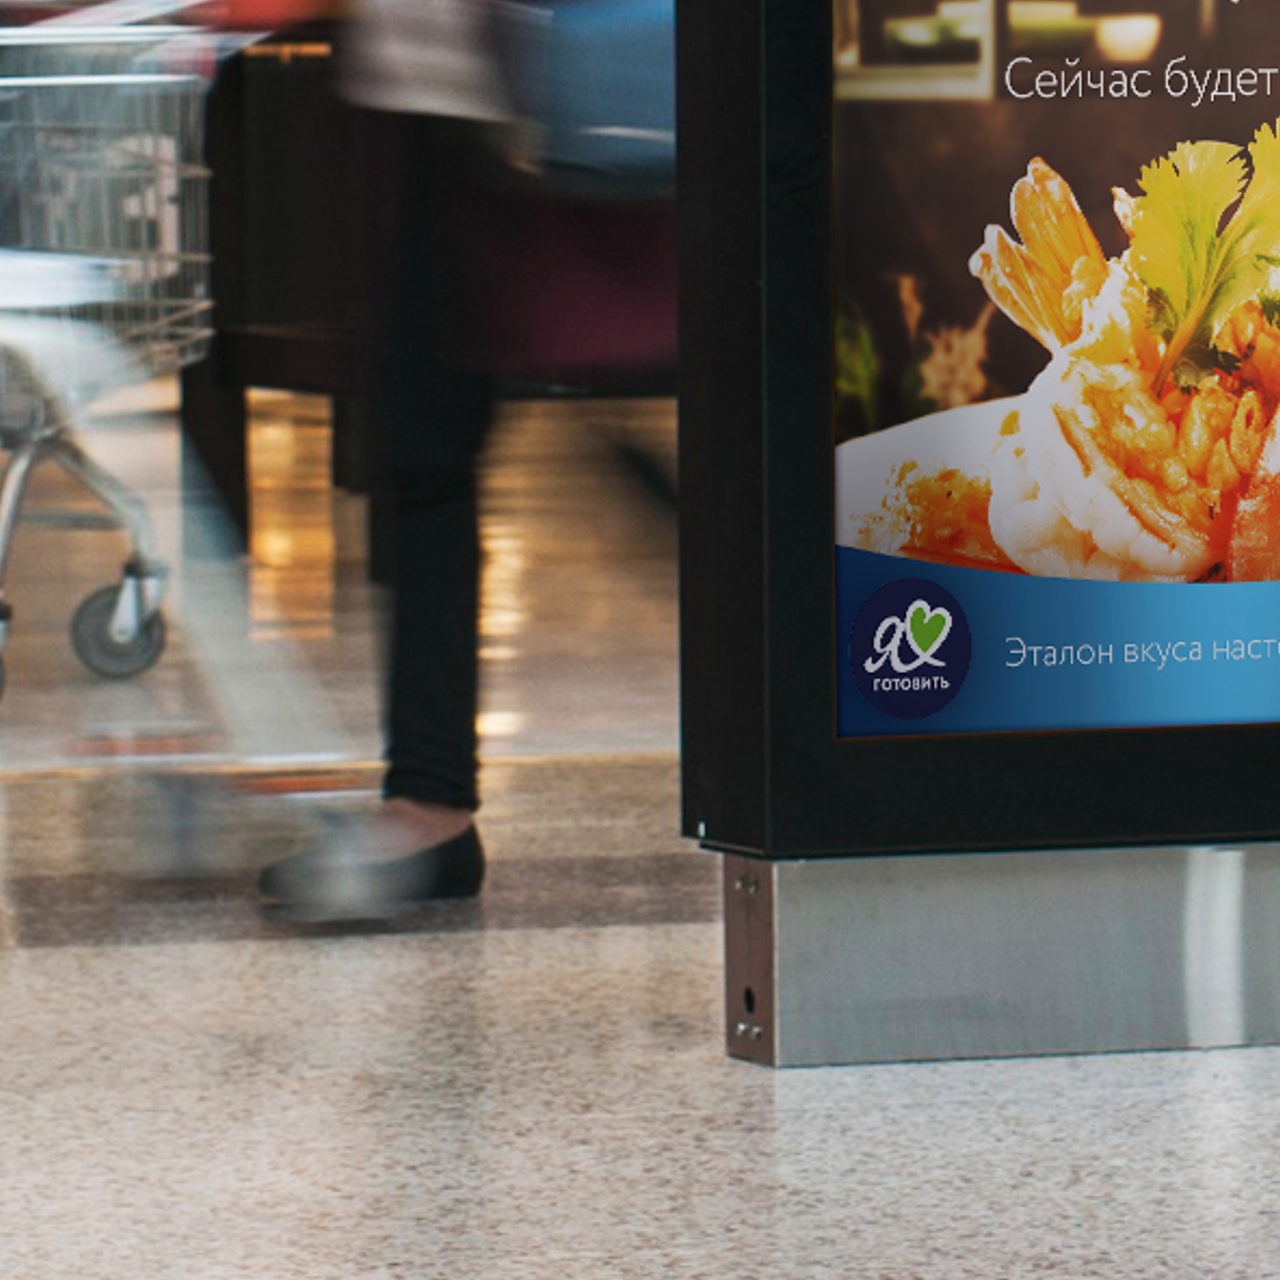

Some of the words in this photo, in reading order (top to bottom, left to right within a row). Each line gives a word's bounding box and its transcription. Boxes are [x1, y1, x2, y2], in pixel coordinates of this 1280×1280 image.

[1004, 56, 1152, 99] Сейчас
[1165, 55, 1279, 108] будет
[1005, 637, 1113, 667] Эталон
[1124, 641, 1202, 670] вкуса
